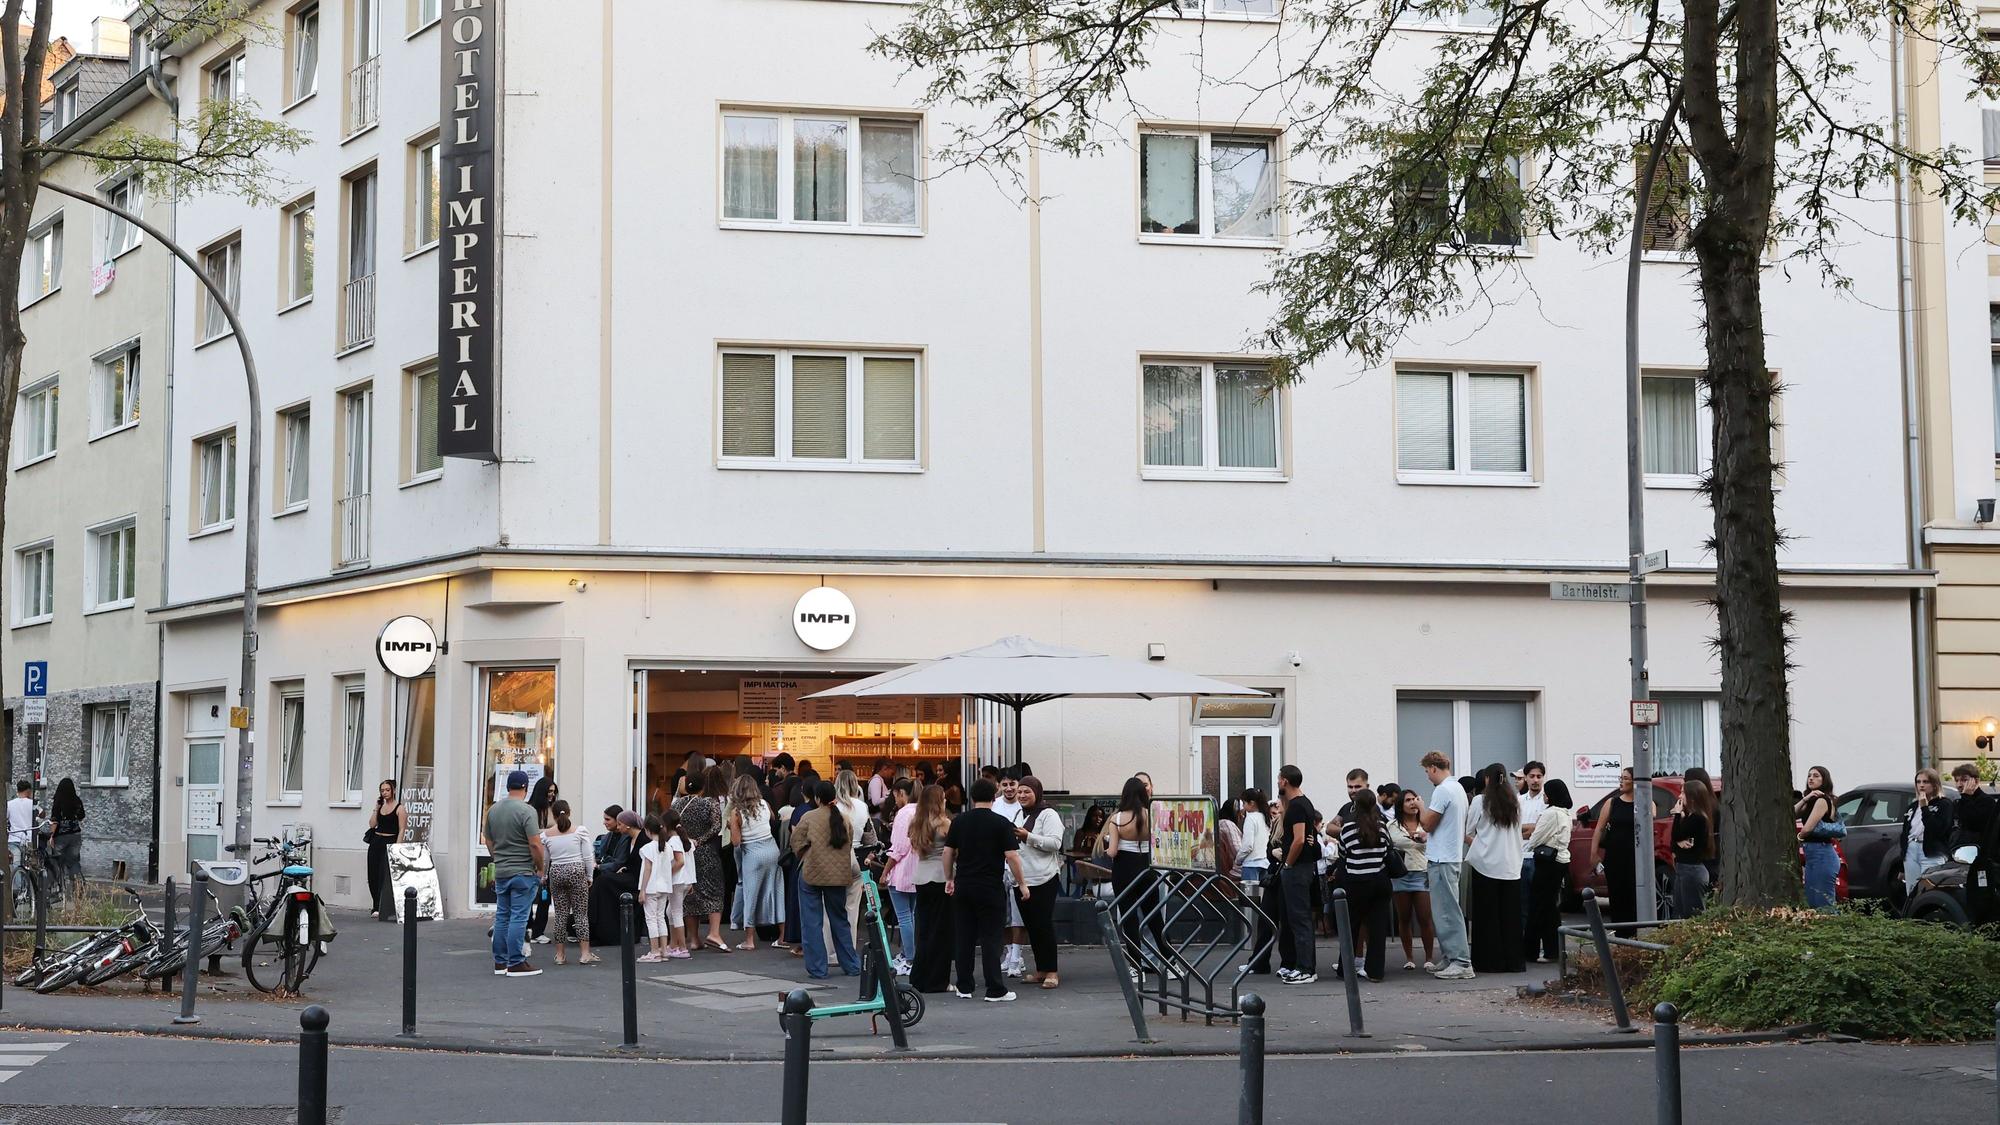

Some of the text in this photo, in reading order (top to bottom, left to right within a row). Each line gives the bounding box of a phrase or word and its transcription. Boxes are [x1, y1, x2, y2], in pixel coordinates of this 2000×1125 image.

[447, 164, 485, 433] IMPERIAL
[1561, 583, 1620, 600] Barthelstr.
[800, 613, 850, 624] IMPI
[385, 641, 432, 652] IMPI
[27, 665, 41, 693] P
[743, 681, 798, 689] IMPI MATCHA
[500, 747, 537, 755] HEALTHY
[402, 788, 416, 800] NOT
